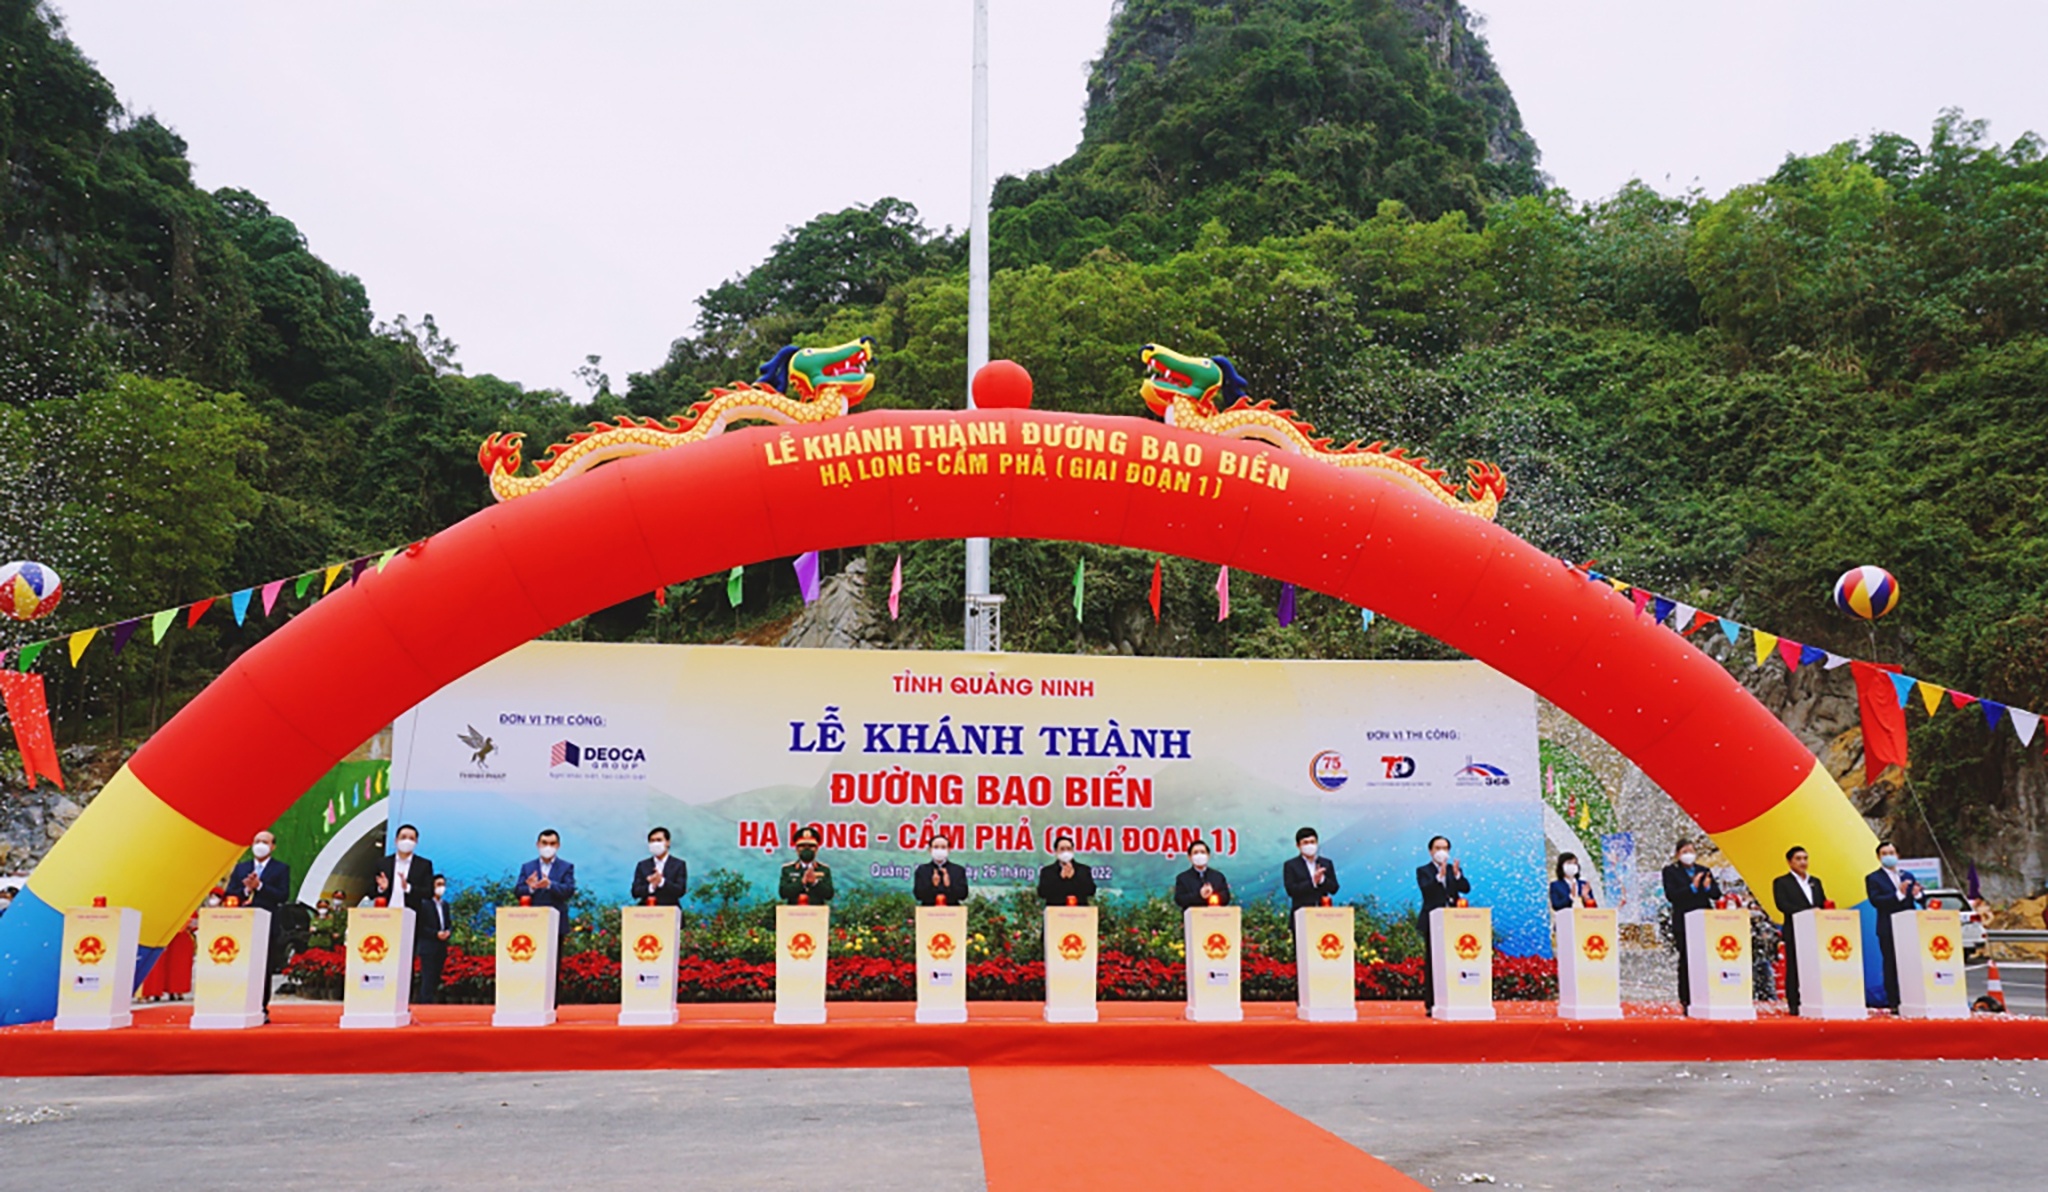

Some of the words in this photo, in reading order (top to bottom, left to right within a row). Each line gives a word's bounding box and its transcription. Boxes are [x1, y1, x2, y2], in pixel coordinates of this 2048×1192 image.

[764, 431, 799, 466] LỄ
[802, 425, 904, 461] KHÁNH
[910, 419, 1007, 449] THÀNH
[1021, 420, 1128, 456] ĐƯỜNG
[1141, 434, 1202, 467] BAO
[1218, 450, 1290, 491] BIỂN
[819, 461, 852, 488] HẠ
[999, 448, 1046, 476] PHẢ
[1125, 462, 1191, 493] ĐOẠN
[893, 669, 942, 693] TỈNH
[950, 671, 1033, 696] QUẢNG
[1041, 679, 1094, 697] NINH
[789, 706, 846, 752] LỄ
[863, 715, 1024, 755] KHÁNH
[1038, 719, 1191, 759] THÀNH
[584, 747, 646, 761] DEOCA
[591, 762, 639, 770] GROUP
[1323, 756, 1341, 770] 75
[830, 766, 963, 805] ĐƯỜNG
[977, 775, 1051, 806] BAO
[1066, 765, 1152, 808] BIỂN
[739, 821, 779, 853] HẠ
[899, 813, 965, 850] CẨM
[976, 816, 1034, 851] PHẢ
[1210, 828, 1237, 855] 1)
[982, 864, 997, 878] 26
